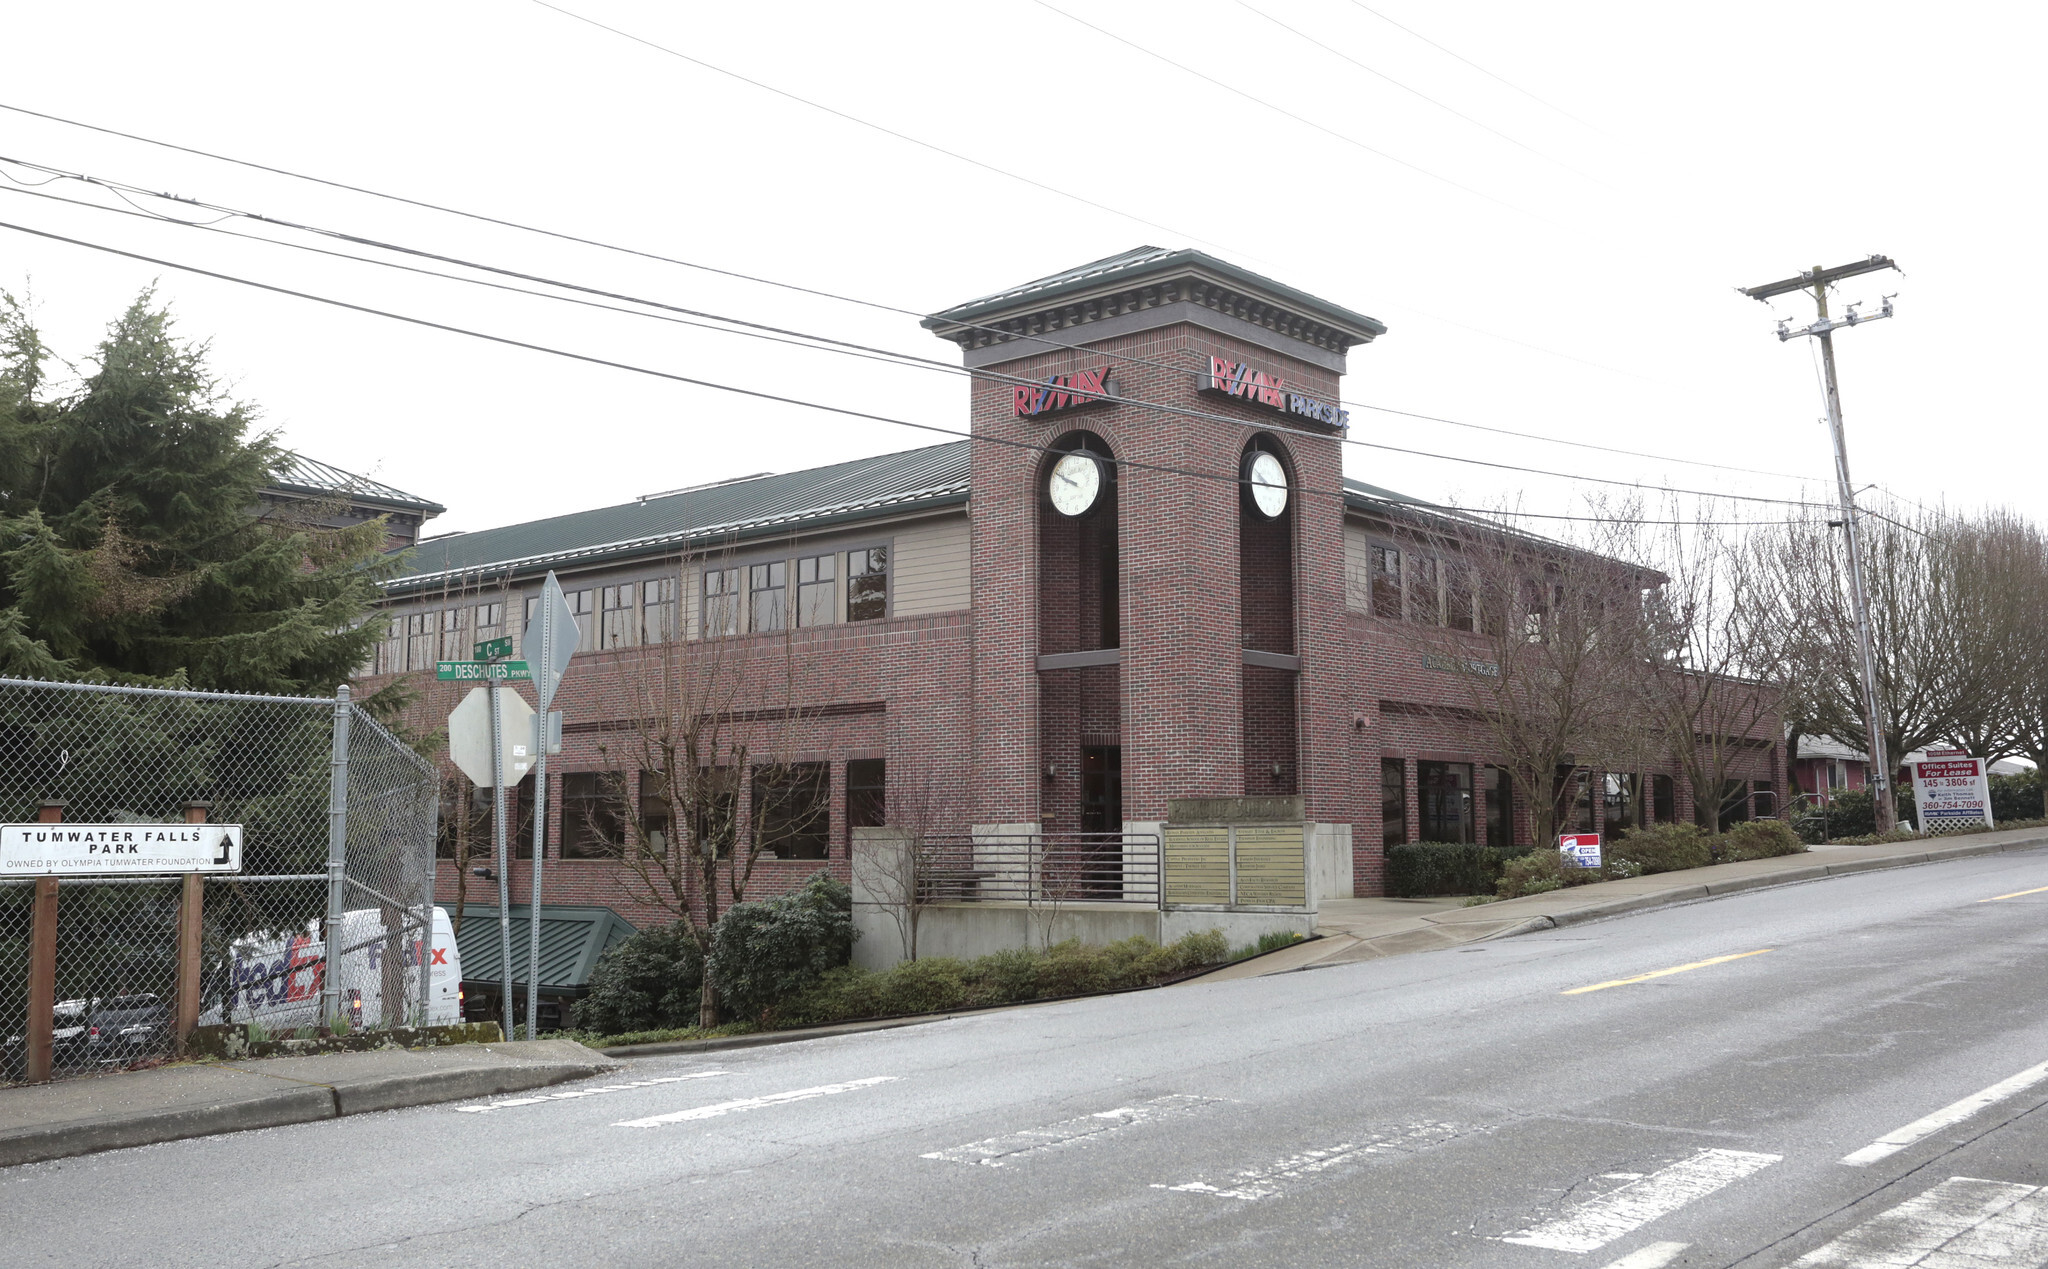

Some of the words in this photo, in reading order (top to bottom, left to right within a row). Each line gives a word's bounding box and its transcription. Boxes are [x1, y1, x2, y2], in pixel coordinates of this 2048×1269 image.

[1013, 367, 1109, 417] RE/MAX
[1210, 356, 1285, 409] RE/MAX
[1291, 393, 1350, 430] PARKSIDE
[486, 643, 493, 656] C
[439, 664, 452, 672] 200
[455, 664, 508, 678] DESCHUTES
[511, 670, 530, 678] PKWY
[1945, 778, 1968, 787] 3806
[1922, 800, 1983, 809] 360-754-7090
[22, 832, 133, 842] TUMWATER
[145, 832, 200, 842] FALLS
[89, 844, 138, 854] PARK
[6, 860, 43, 868] OWNED
[61, 859, 102, 867] OLYMPIA
[156, 858, 211, 866] FOUNDATION
